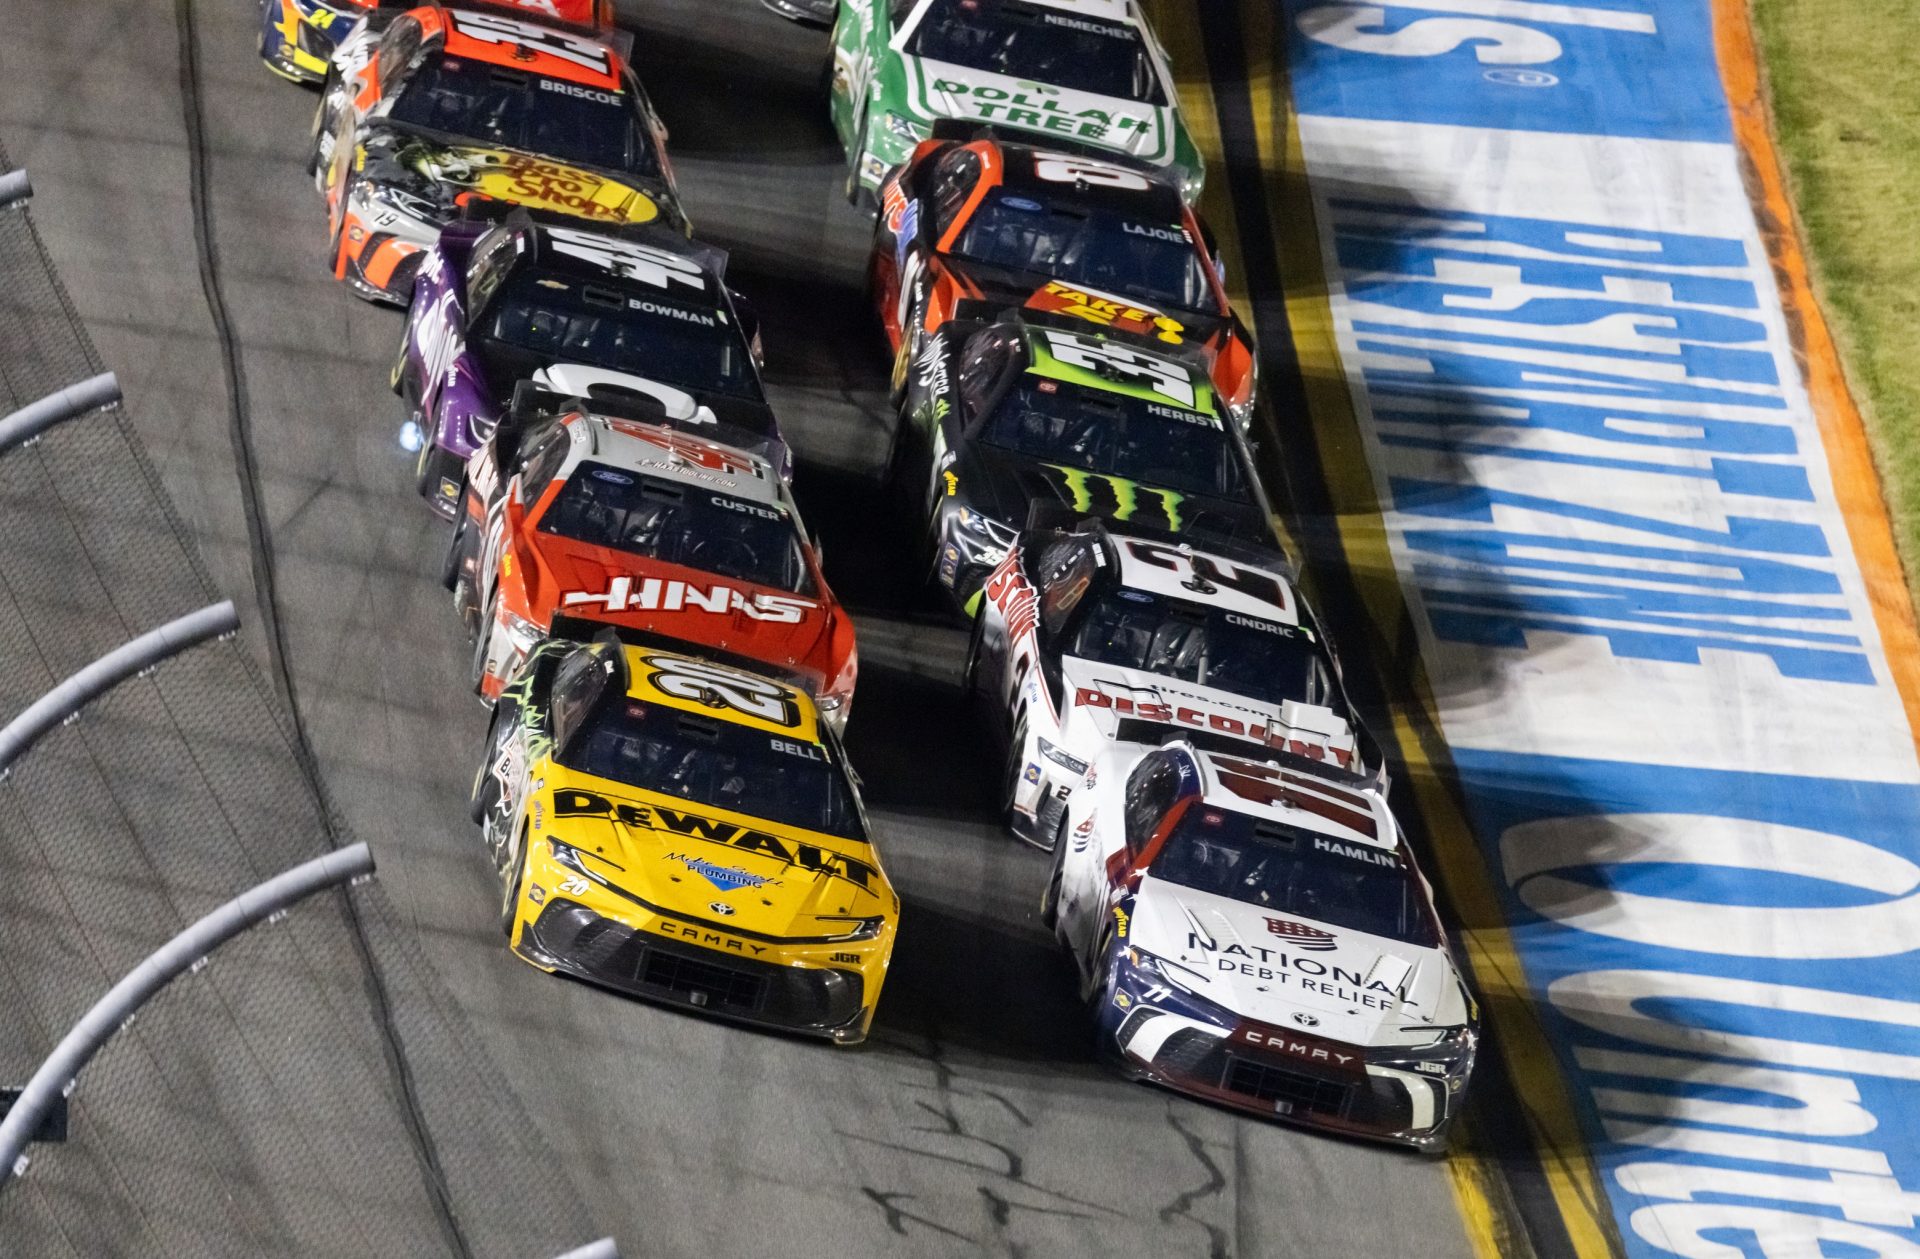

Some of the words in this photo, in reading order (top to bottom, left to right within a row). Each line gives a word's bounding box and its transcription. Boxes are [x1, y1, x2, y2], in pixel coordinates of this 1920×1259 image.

[309, 9, 336, 29] 24
[1044, 13, 1135, 40] NEMECHEK
[540, 79, 622, 106] BRISCOE
[932, 79, 1152, 132] DOLLAR
[973, 102, 1109, 139] TREE
[375, 211, 398, 226] 19
[1122, 222, 1183, 244] LAJOIE
[629, 299, 714, 327] BOWMAN
[1045, 283, 1149, 321] TAKE
[1147, 404, 1219, 428] HERBST
[711, 497, 780, 521] CUSTER
[1225, 614, 1294, 638] CINDRIC
[641, 657, 798, 726] 20
[1150, 684, 1273, 718] tires.com
[1075, 687, 1354, 770] DISCOUNT
[771, 740, 820, 763] BELL
[1056, 785, 1072, 801] 2
[1314, 838, 1396, 868] HAMLIN
[559, 875, 590, 896] 20
[687, 865, 763, 889] PLUMBING
[660, 922, 768, 955] CAMRY
[829, 952, 861, 964] JGR
[1188, 933, 1419, 1006] NATIONAL
[1143, 984, 1172, 1003] 11
[1218, 958, 1291, 984] DEBT
[1302, 977, 1393, 1011] RELIEF
[1246, 1030, 1356, 1065] CAMRY
[1415, 1062, 1446, 1075] JGR
